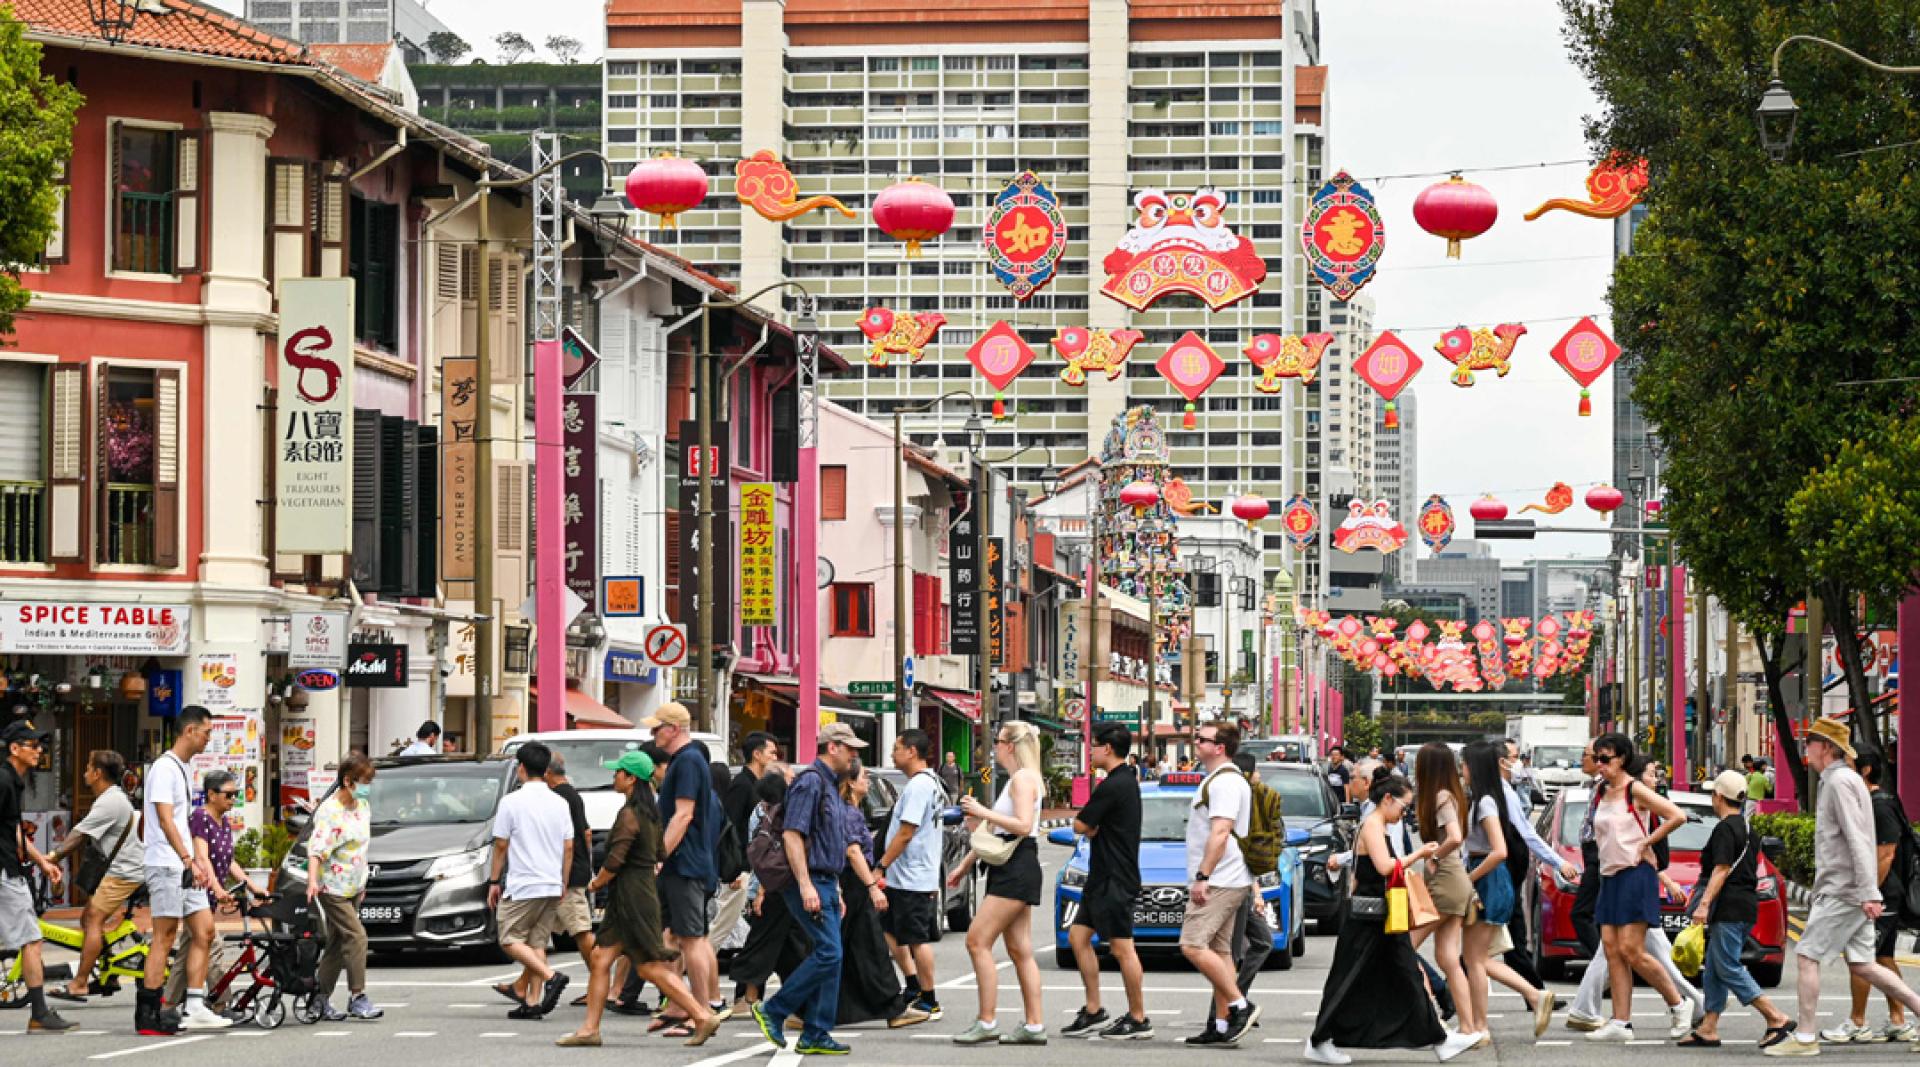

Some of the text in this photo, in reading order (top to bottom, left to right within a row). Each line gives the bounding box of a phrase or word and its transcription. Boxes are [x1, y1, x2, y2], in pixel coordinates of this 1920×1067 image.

[1001, 212, 1050, 254] 如
[1320, 209, 1365, 256] 意
[991, 345, 1010, 366] 万
[1576, 338, 1598, 364] 意
[1181, 352, 1202, 377] 事
[1377, 352, 1400, 375] 如
[296, 472, 328, 481] EIGHT
[285, 484, 341, 494] TREASURES
[281, 497, 345, 508] VEGETARIAN
[454, 456, 465, 563] ANOTHER DAY
[1291, 510, 1308, 531] 吉
[19, 605, 174, 625] SPICE TABLE
[24, 629, 56, 638] Indian
[60, 629, 66, 638] &
[70, 630, 142, 640] Mediterranean
[306, 637, 330, 645] SPICE
[349, 658, 387, 674] Asahi
[300, 674, 334, 687] OPEN
[853, 682, 887, 692] Smith
[1167, 774, 1201, 783] HIRED
